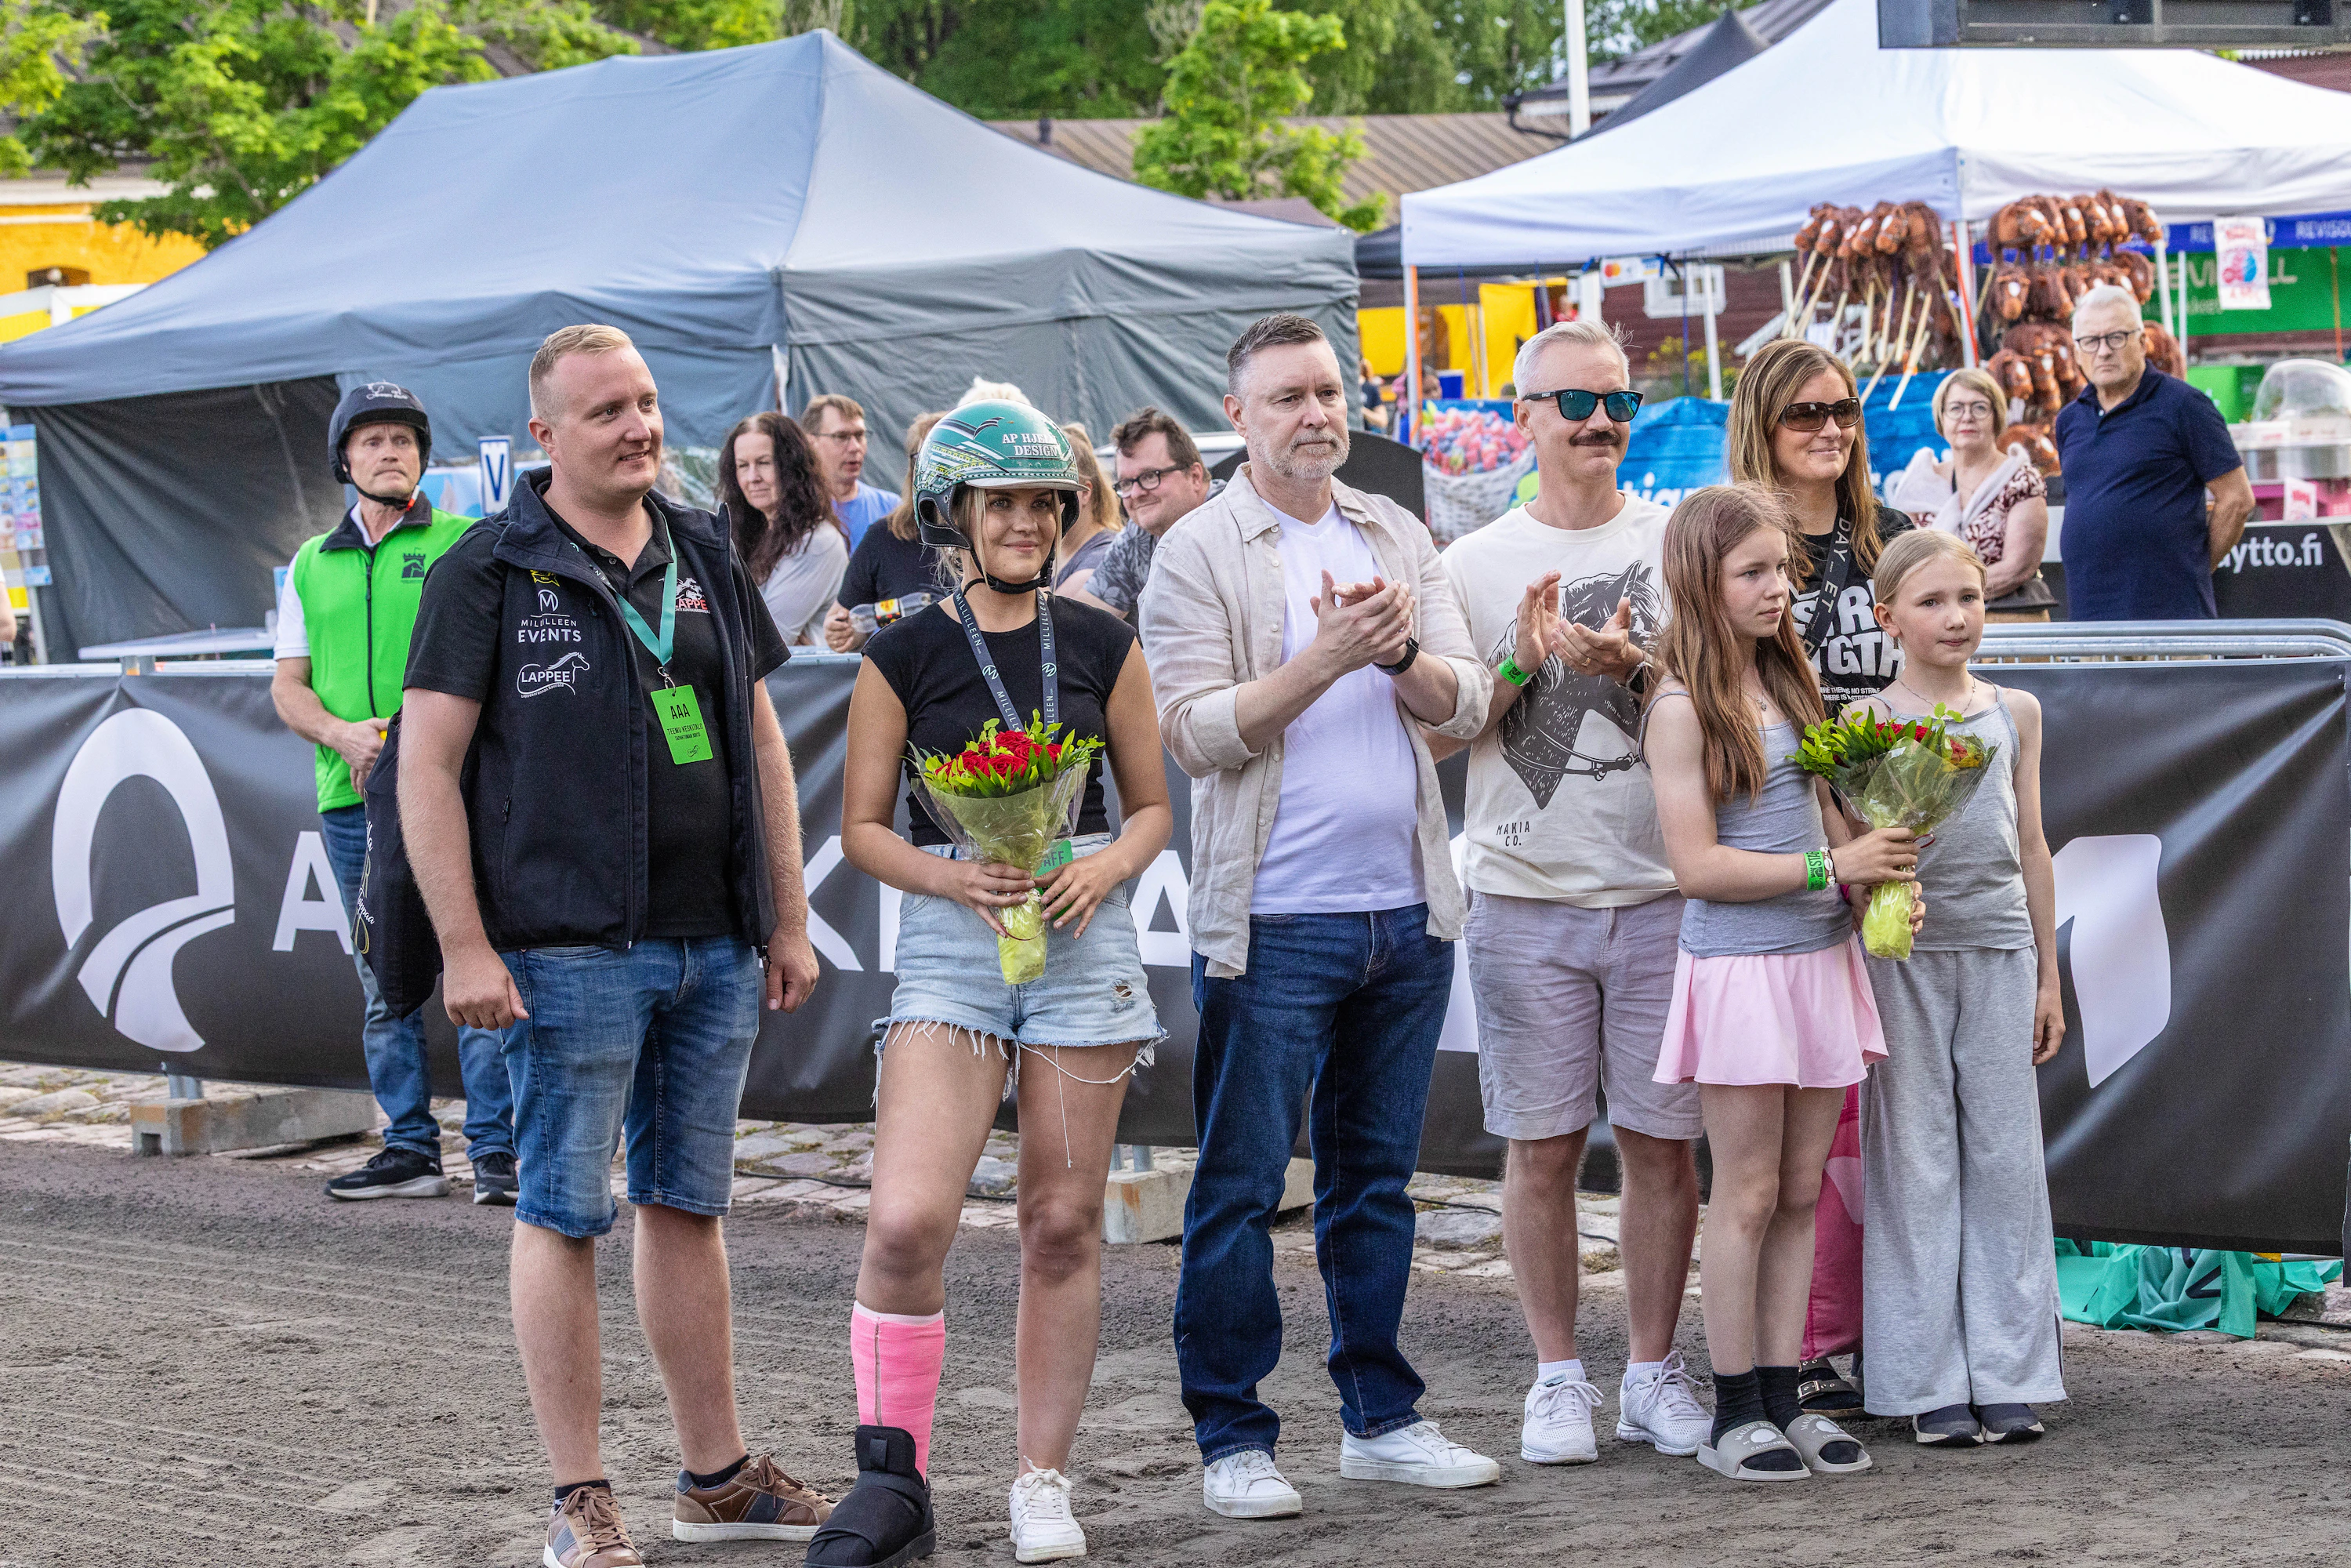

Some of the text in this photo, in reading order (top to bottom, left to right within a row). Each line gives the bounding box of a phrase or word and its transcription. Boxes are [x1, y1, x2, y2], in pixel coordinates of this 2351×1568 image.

[1003, 434, 1018, 444] AP
[1014, 445, 1058, 457] DESIGN
[485, 454, 504, 502] V
[1831, 517, 1851, 563] DAY
[1821, 580, 1838, 614] ET
[518, 628, 582, 643] EVENTS
[521, 670, 571, 683] LAPPEE
[669, 703, 691, 720] AAA
[667, 723, 703, 735] TEEMU KESKITALO
[1496, 821, 1530, 836] MAKIA
[1505, 835, 1522, 847] CO.
[1734, 1423, 1758, 1441] MALIBU
[1751, 1440, 1789, 1451] CALIFORNIA
